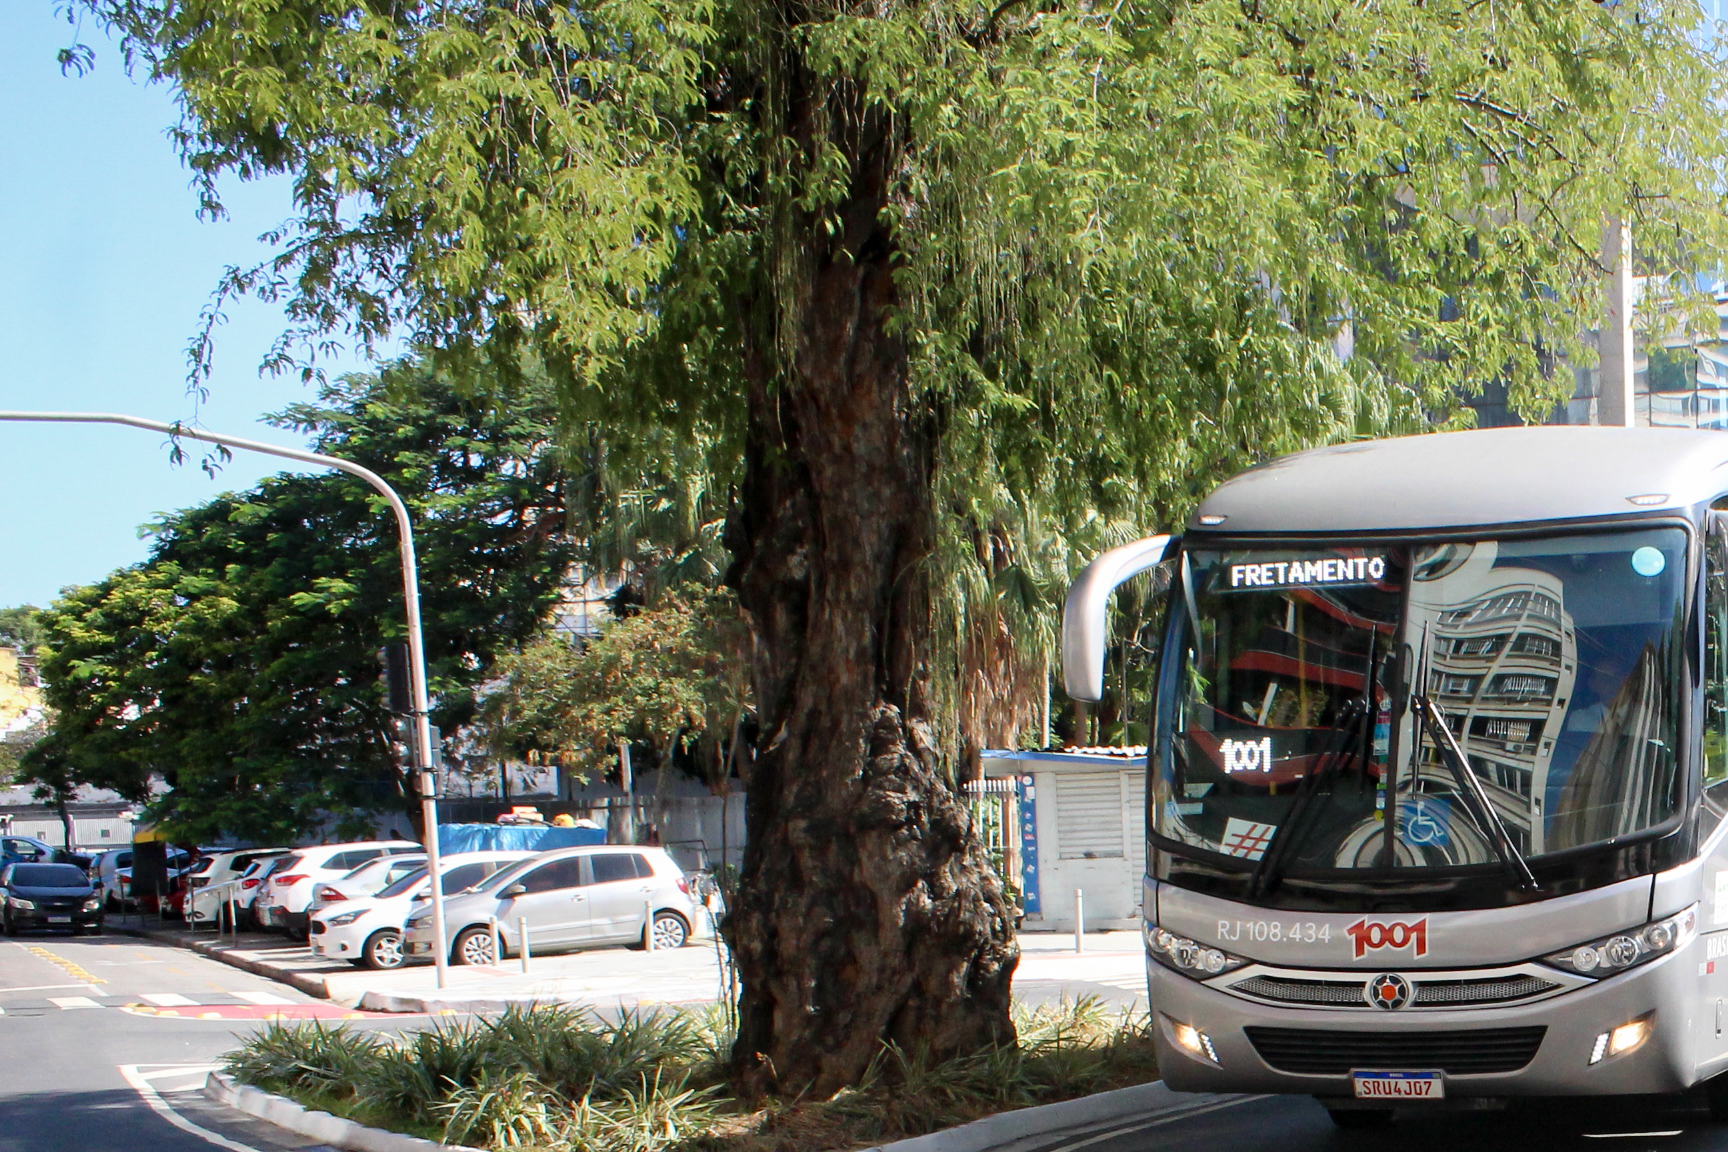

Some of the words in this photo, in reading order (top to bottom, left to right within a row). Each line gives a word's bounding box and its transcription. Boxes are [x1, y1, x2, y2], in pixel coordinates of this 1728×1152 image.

[1231, 556, 1385, 588] FRETAMENTO
[1219, 736, 1271, 774] 1001
[1217, 920, 1242, 941] RJ
[1248, 920, 1331, 944] 108.434
[1346, 914, 1430, 961] 1001
[1362, 1080, 1432, 1096] SRU4J07
